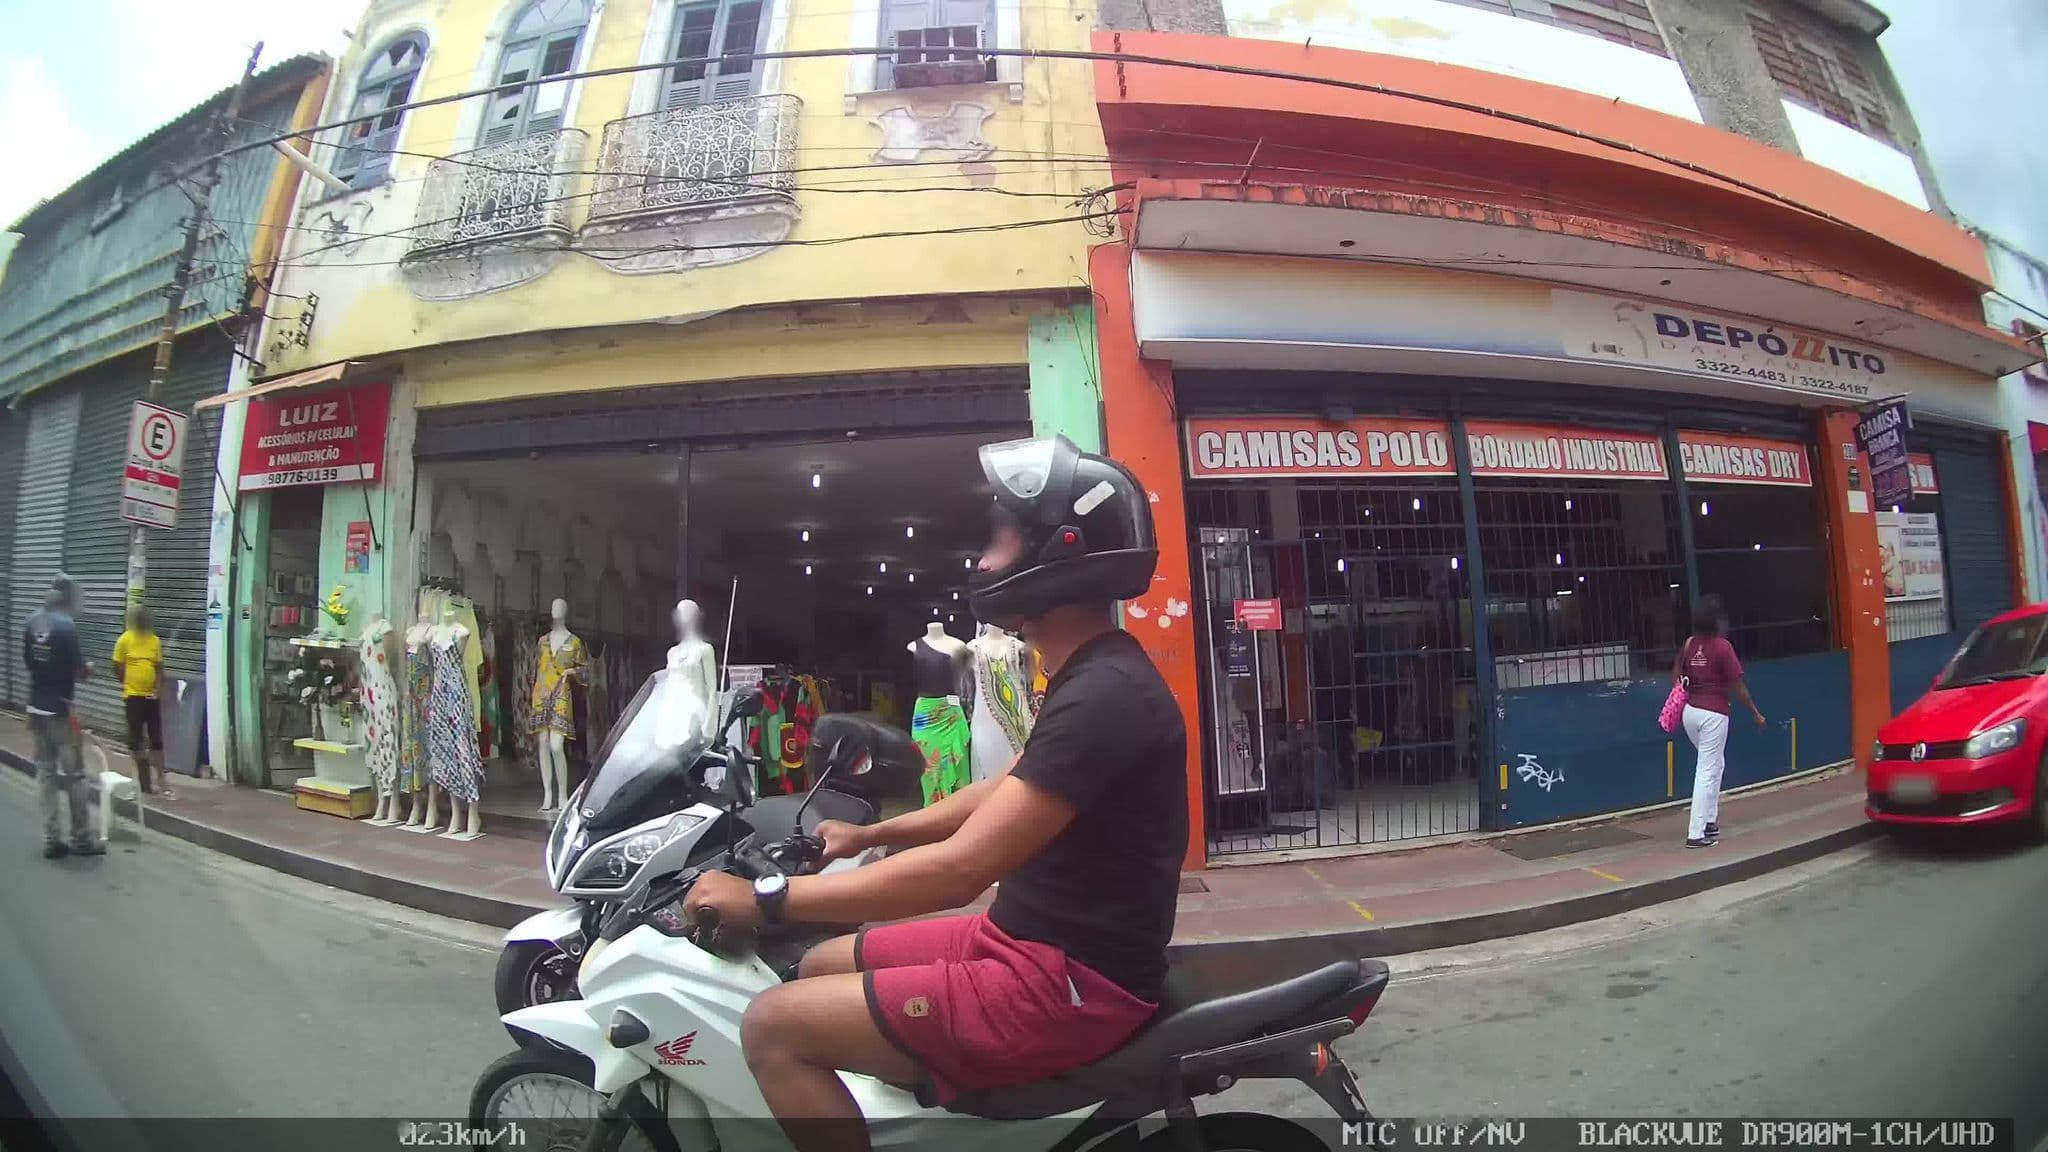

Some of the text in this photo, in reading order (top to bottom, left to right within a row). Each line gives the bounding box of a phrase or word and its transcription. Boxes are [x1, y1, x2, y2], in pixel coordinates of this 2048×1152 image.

[1653, 312, 1886, 374] DEPÓZZITO
[1696, 358, 1787, 383] 3322-4483
[1799, 376, 1869, 395] 3322-4187
[279, 402, 338, 426] LUIZ
[1859, 406, 1901, 440] CAMISA
[151, 422, 166, 450] E
[258, 431, 305, 449] ACESSÓRIOS
[1197, 430, 1449, 469] CAMISAS POLO
[277, 445, 340, 465] MANUTENÇÃO
[1467, 434, 1662, 472] BORDADO INDUSTRIAL
[1679, 443, 1801, 479] CAMISAS DRY
[267, 468, 338, 485] 98776-0139
[658, 1058, 706, 1066] HONDA
